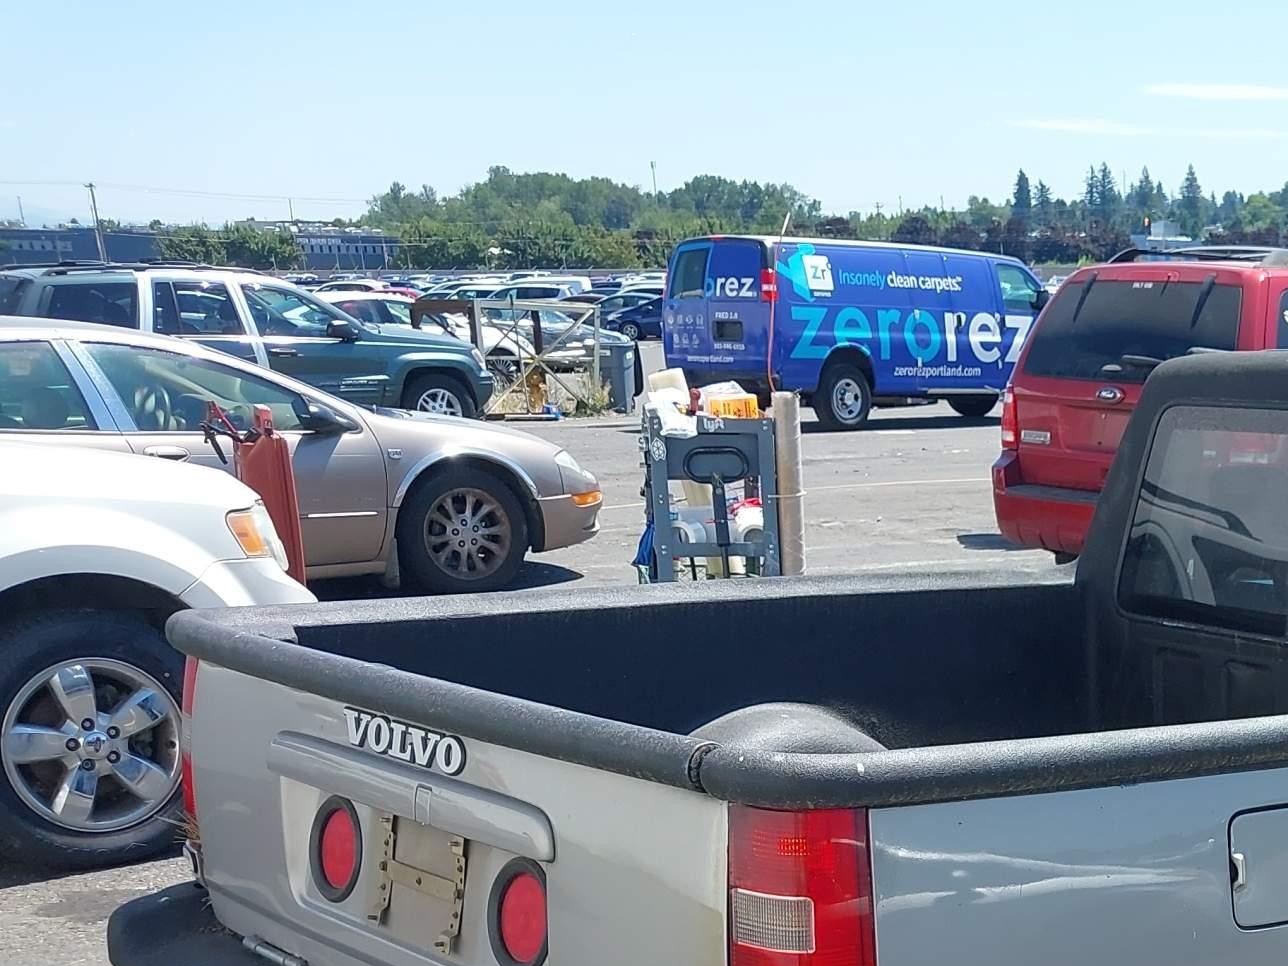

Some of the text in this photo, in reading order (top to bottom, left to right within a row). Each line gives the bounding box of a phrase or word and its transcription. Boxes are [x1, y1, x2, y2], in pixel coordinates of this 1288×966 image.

[838, 268, 885, 290] Insanely
[886, 270, 918, 289] clean
[789, 305, 1034, 363] zerorez
[893, 364, 982, 379] zerorezportland.com
[343, 706, 467, 777] VOLVO
